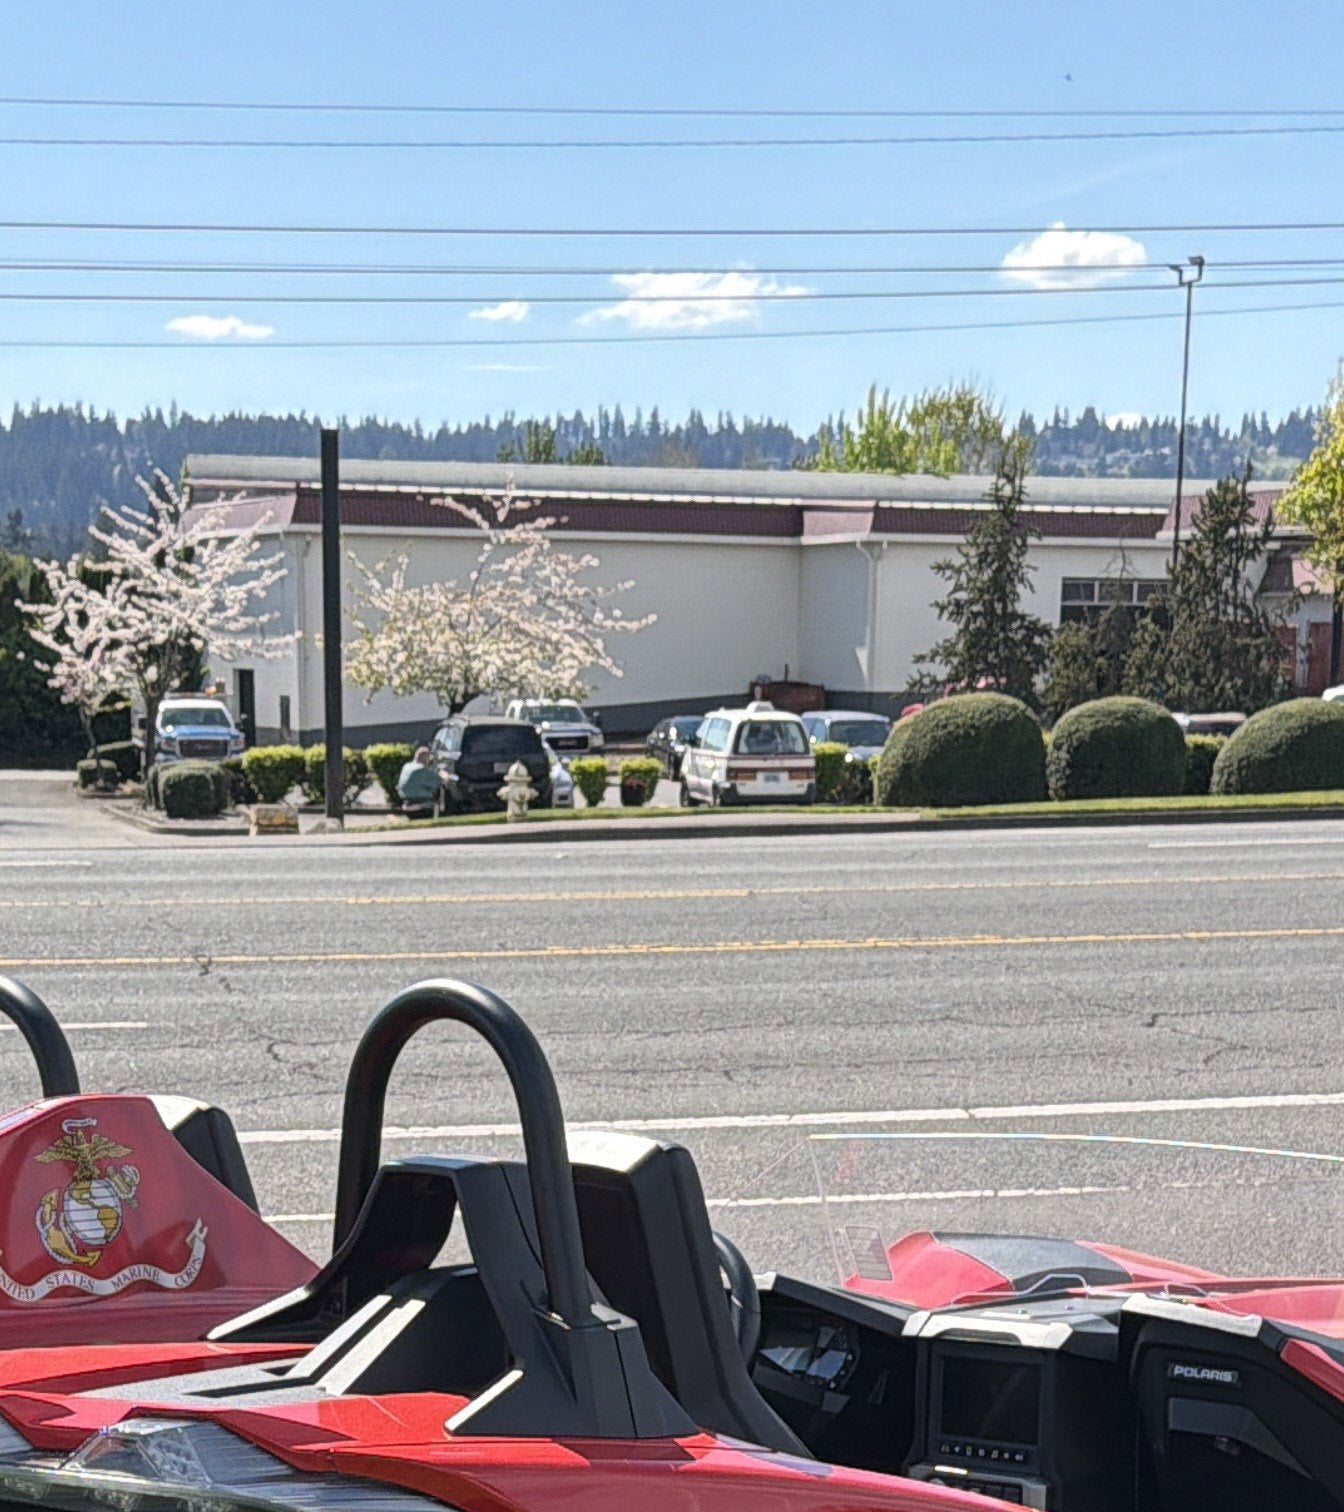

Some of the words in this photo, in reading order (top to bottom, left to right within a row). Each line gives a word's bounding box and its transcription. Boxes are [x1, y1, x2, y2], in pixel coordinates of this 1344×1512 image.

[45, 1272, 95, 1291] STATES
[111, 1264, 160, 1291] MARINE
[173, 1255, 202, 1288] CORPS
[1173, 1364, 1233, 1383] POLARIS
